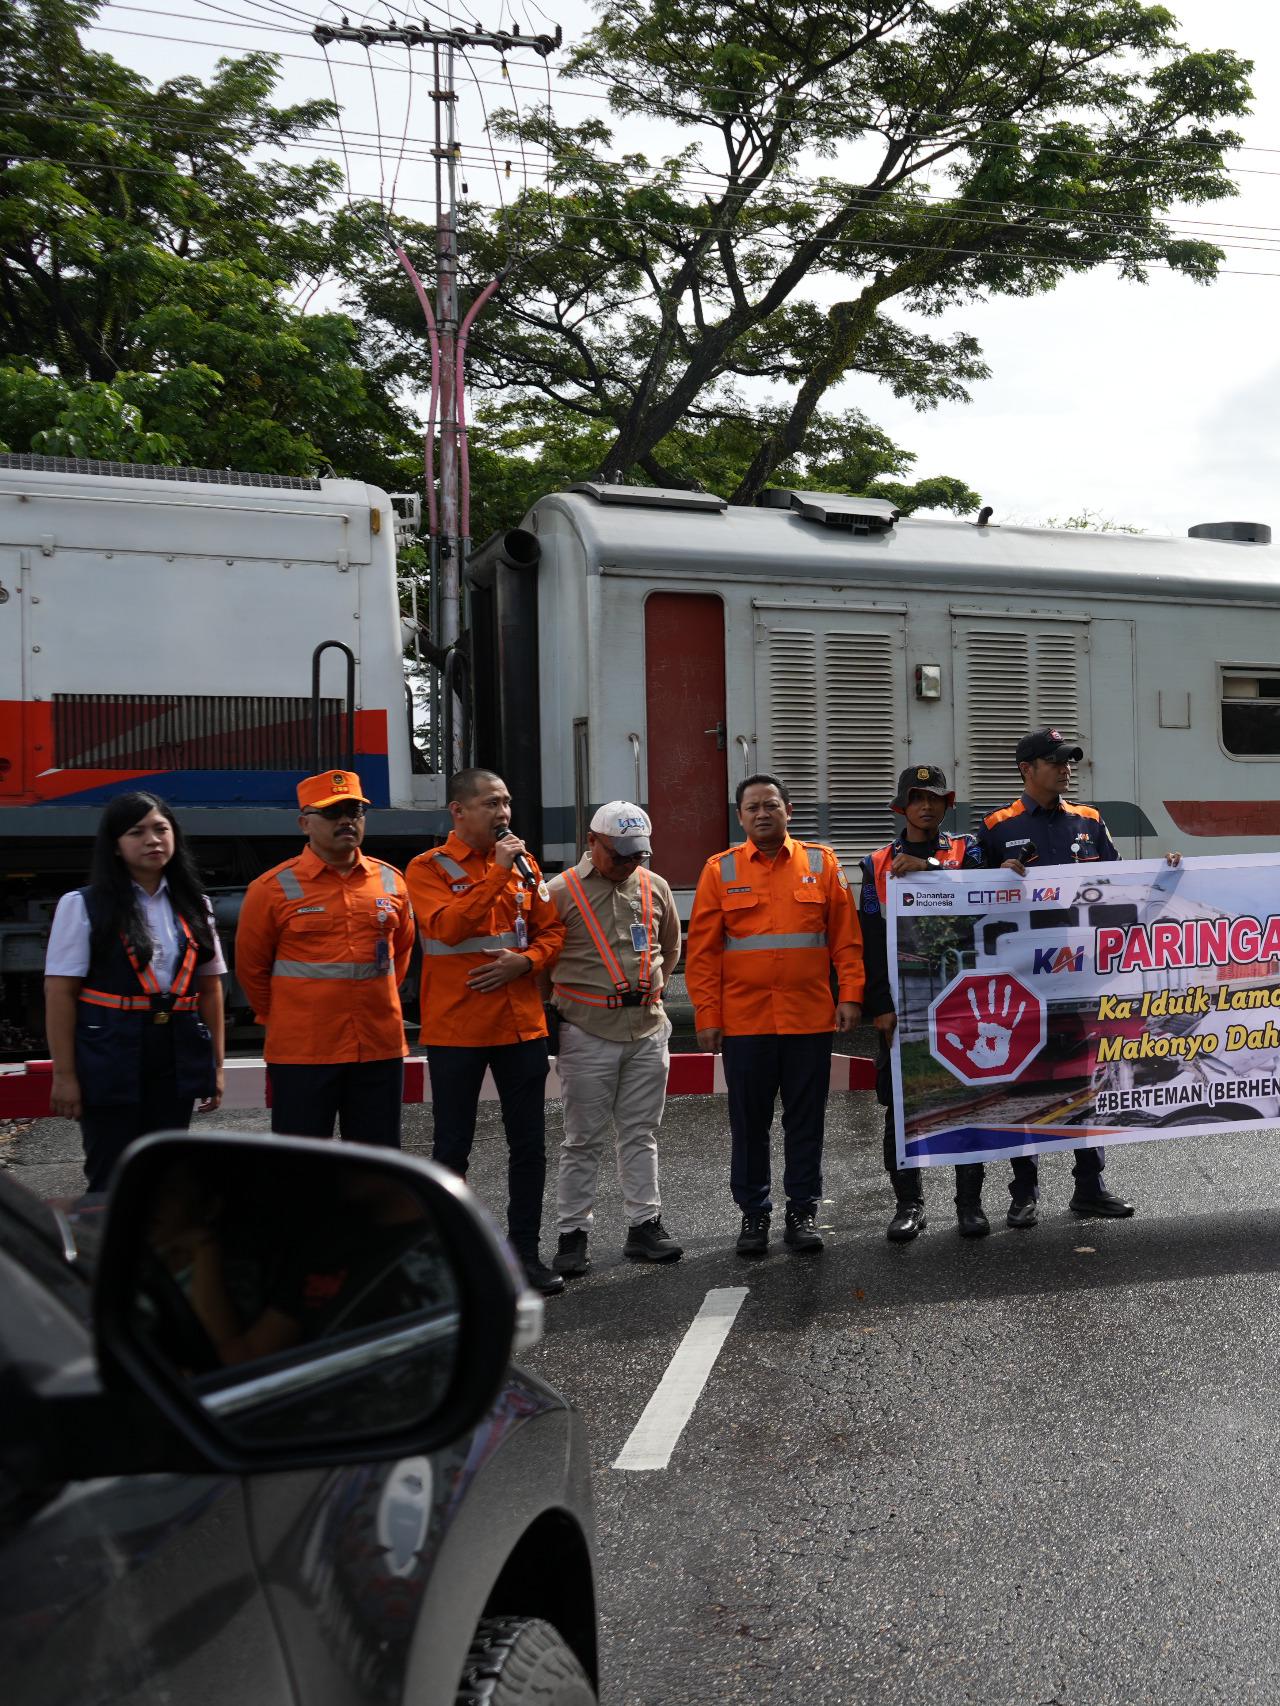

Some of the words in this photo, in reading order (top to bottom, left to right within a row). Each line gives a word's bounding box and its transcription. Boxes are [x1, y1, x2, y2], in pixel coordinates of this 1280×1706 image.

[916, 892, 955, 900] Danantara
[1033, 945, 1084, 975] KAI
[1098, 994, 1132, 1020] Ka
[1141, 985, 1210, 1017] Iduik
[1096, 1032, 1218, 1063] Makonyo
[1097, 1084, 1202, 1112] #BERTEMAN
